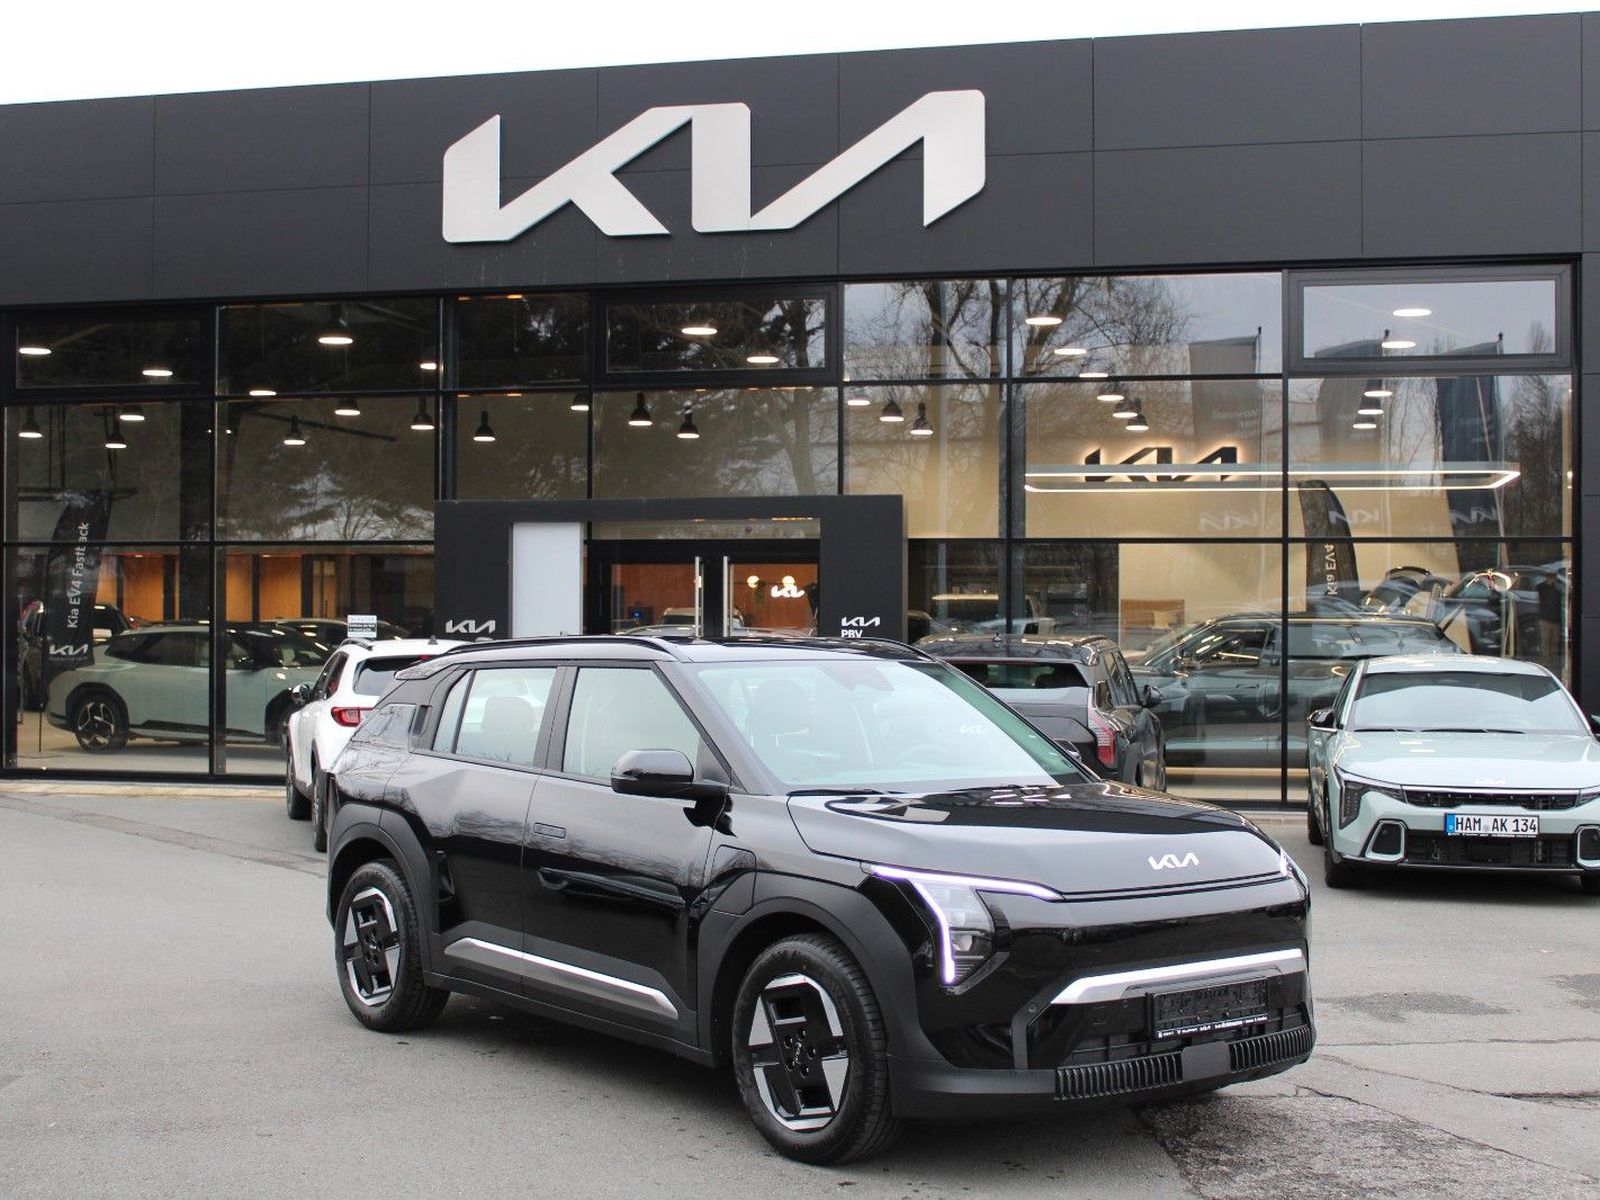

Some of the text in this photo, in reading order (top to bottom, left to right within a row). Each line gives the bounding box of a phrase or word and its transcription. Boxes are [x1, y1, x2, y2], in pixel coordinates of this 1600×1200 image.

[443, 89, 986, 244] KIA
[1085, 446, 1238, 483] KIA
[68, 580, 81, 604] EV4
[67, 609, 80, 629] Kia
[445, 619, 496, 634] KIA
[841, 616, 880, 627] KIA
[841, 629, 863, 638] PBV
[49, 643, 89, 656] KIA
[1455, 816, 1537, 833] HAM AK 134
[1147, 852, 1200, 870] KIA
